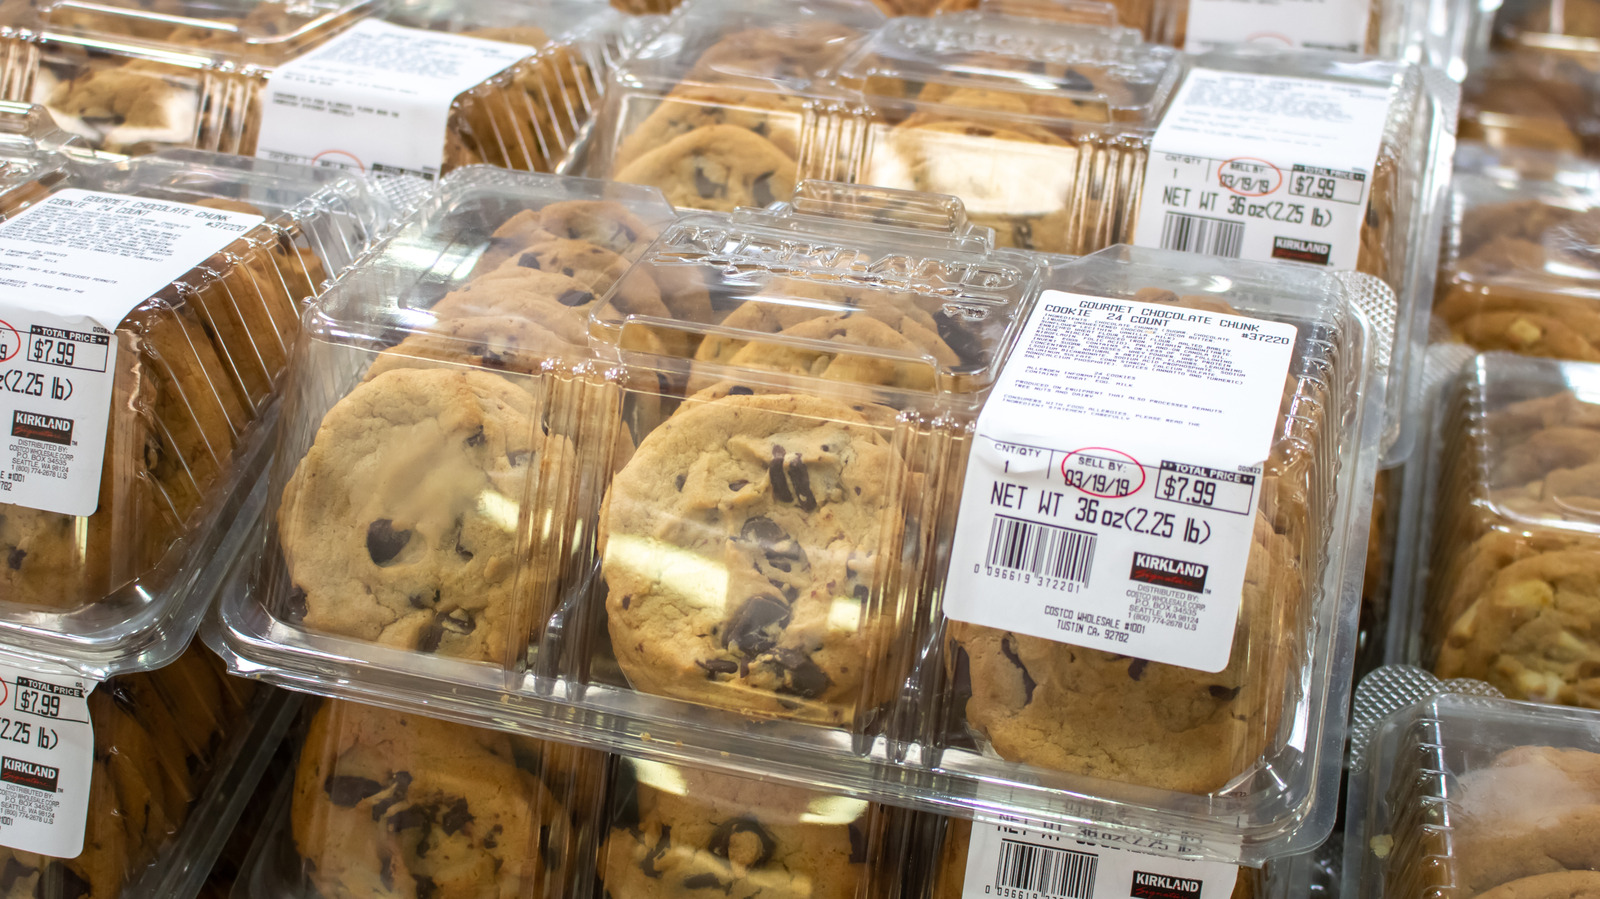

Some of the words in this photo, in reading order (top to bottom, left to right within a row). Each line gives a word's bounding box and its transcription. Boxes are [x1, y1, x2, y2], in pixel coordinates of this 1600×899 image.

[1220, 173, 1270, 193] 03/19/19
[1295, 175, 1336, 199] $7.99
[48, 198, 88, 208] COOKIE
[115, 207, 151, 216] COUNT
[83, 195, 130, 205] GOURMET
[132, 202, 193, 215] CHOCOLATE
[195, 212, 229, 221] CHUNK
[1163, 186, 1190, 207] NET
[1199, 192, 1218, 211] WT
[1228, 195, 1246, 214] 36
[1276, 238, 1328, 254] KIRKLAND
[1044, 304, 1091, 317] COOKIE
[1130, 316, 1169, 327] COUNT
[1242, 333, 1289, 345] #37220
[1079, 301, 1133, 313] GOURMET
[1141, 308, 1212, 324] CHOCOLATE
[1220, 319, 1260, 332] CHUNK
[43, 328, 67, 338] TOTAL
[70, 332, 96, 343] PRICE
[32, 338, 75, 366] $7.99
[52, 376, 73, 401] lb)
[16, 413, 70, 431] KIRKLAND
[9, 444, 28, 453] COSTCO
[30, 448, 58, 458] WHOLESALE
[18, 439, 57, 451] DISTRIBUTED
[995, 443, 1041, 457] CNT/QTY
[12, 457, 39, 468] SEATTLE,
[16, 465, 29, 473] (800)
[47, 457, 66, 466] 34535
[1004, 460, 1009, 473] 1
[1078, 456, 1104, 468] SELL
[1108, 462, 1125, 471] BY:
[1175, 463, 1208, 477] TOTAL
[1210, 469, 1241, 482] PRICE
[1064, 469, 1130, 497] 03/19/19
[1162, 475, 1216, 507] $7.99
[990, 481, 1028, 510] NET
[1038, 490, 1063, 517] WT
[1075, 497, 1099, 523] 36
[1184, 518, 1210, 544] lb)
[1136, 554, 1204, 578] KIRKLAND
[974, 564, 979, 573] 0
[987, 566, 1030, 583] 096619
[1037, 576, 1080, 593] 372201
[1126, 590, 1151, 600] COSTCO
[1152, 595, 1187, 607] WHOLESALE
[1188, 602, 1206, 610] CORP.
[1138, 584, 1186, 599] DISTRIBUTED
[1188, 594, 1198, 602] BY:
[1129, 604, 1162, 617] SEATTLE,
[1178, 615, 1199, 624] 98124
[1135, 598, 1149, 607] P.O.
[1153, 602, 1170, 610] BOX
[1173, 606, 1197, 616] 34535
[1044, 606, 1074, 619] COSTCO
[1077, 612, 1120, 628] WHOLESALE
[1124, 622, 1145, 633] #1001
[1133, 613, 1150, 623] (800)
[1152, 617, 1182, 628] 774-2678
[1058, 619, 1084, 633] TUSTIN
[1104, 629, 1129, 643] 92782
[27, 680, 52, 691] TOTAL
[54, 686, 79, 696] PRICE
[19, 690, 60, 717] $7.99
[0, 717, 31, 744] 2.25
[38, 727, 58, 750] lb)
[4, 759, 56, 779] KIRKLAND
[6, 784, 43, 797] DISTRIBUTED
[18, 794, 44, 804] WHOLESALE
[38, 810, 54, 818] 98124
[1136, 873, 1198, 892] KIRKLAND
